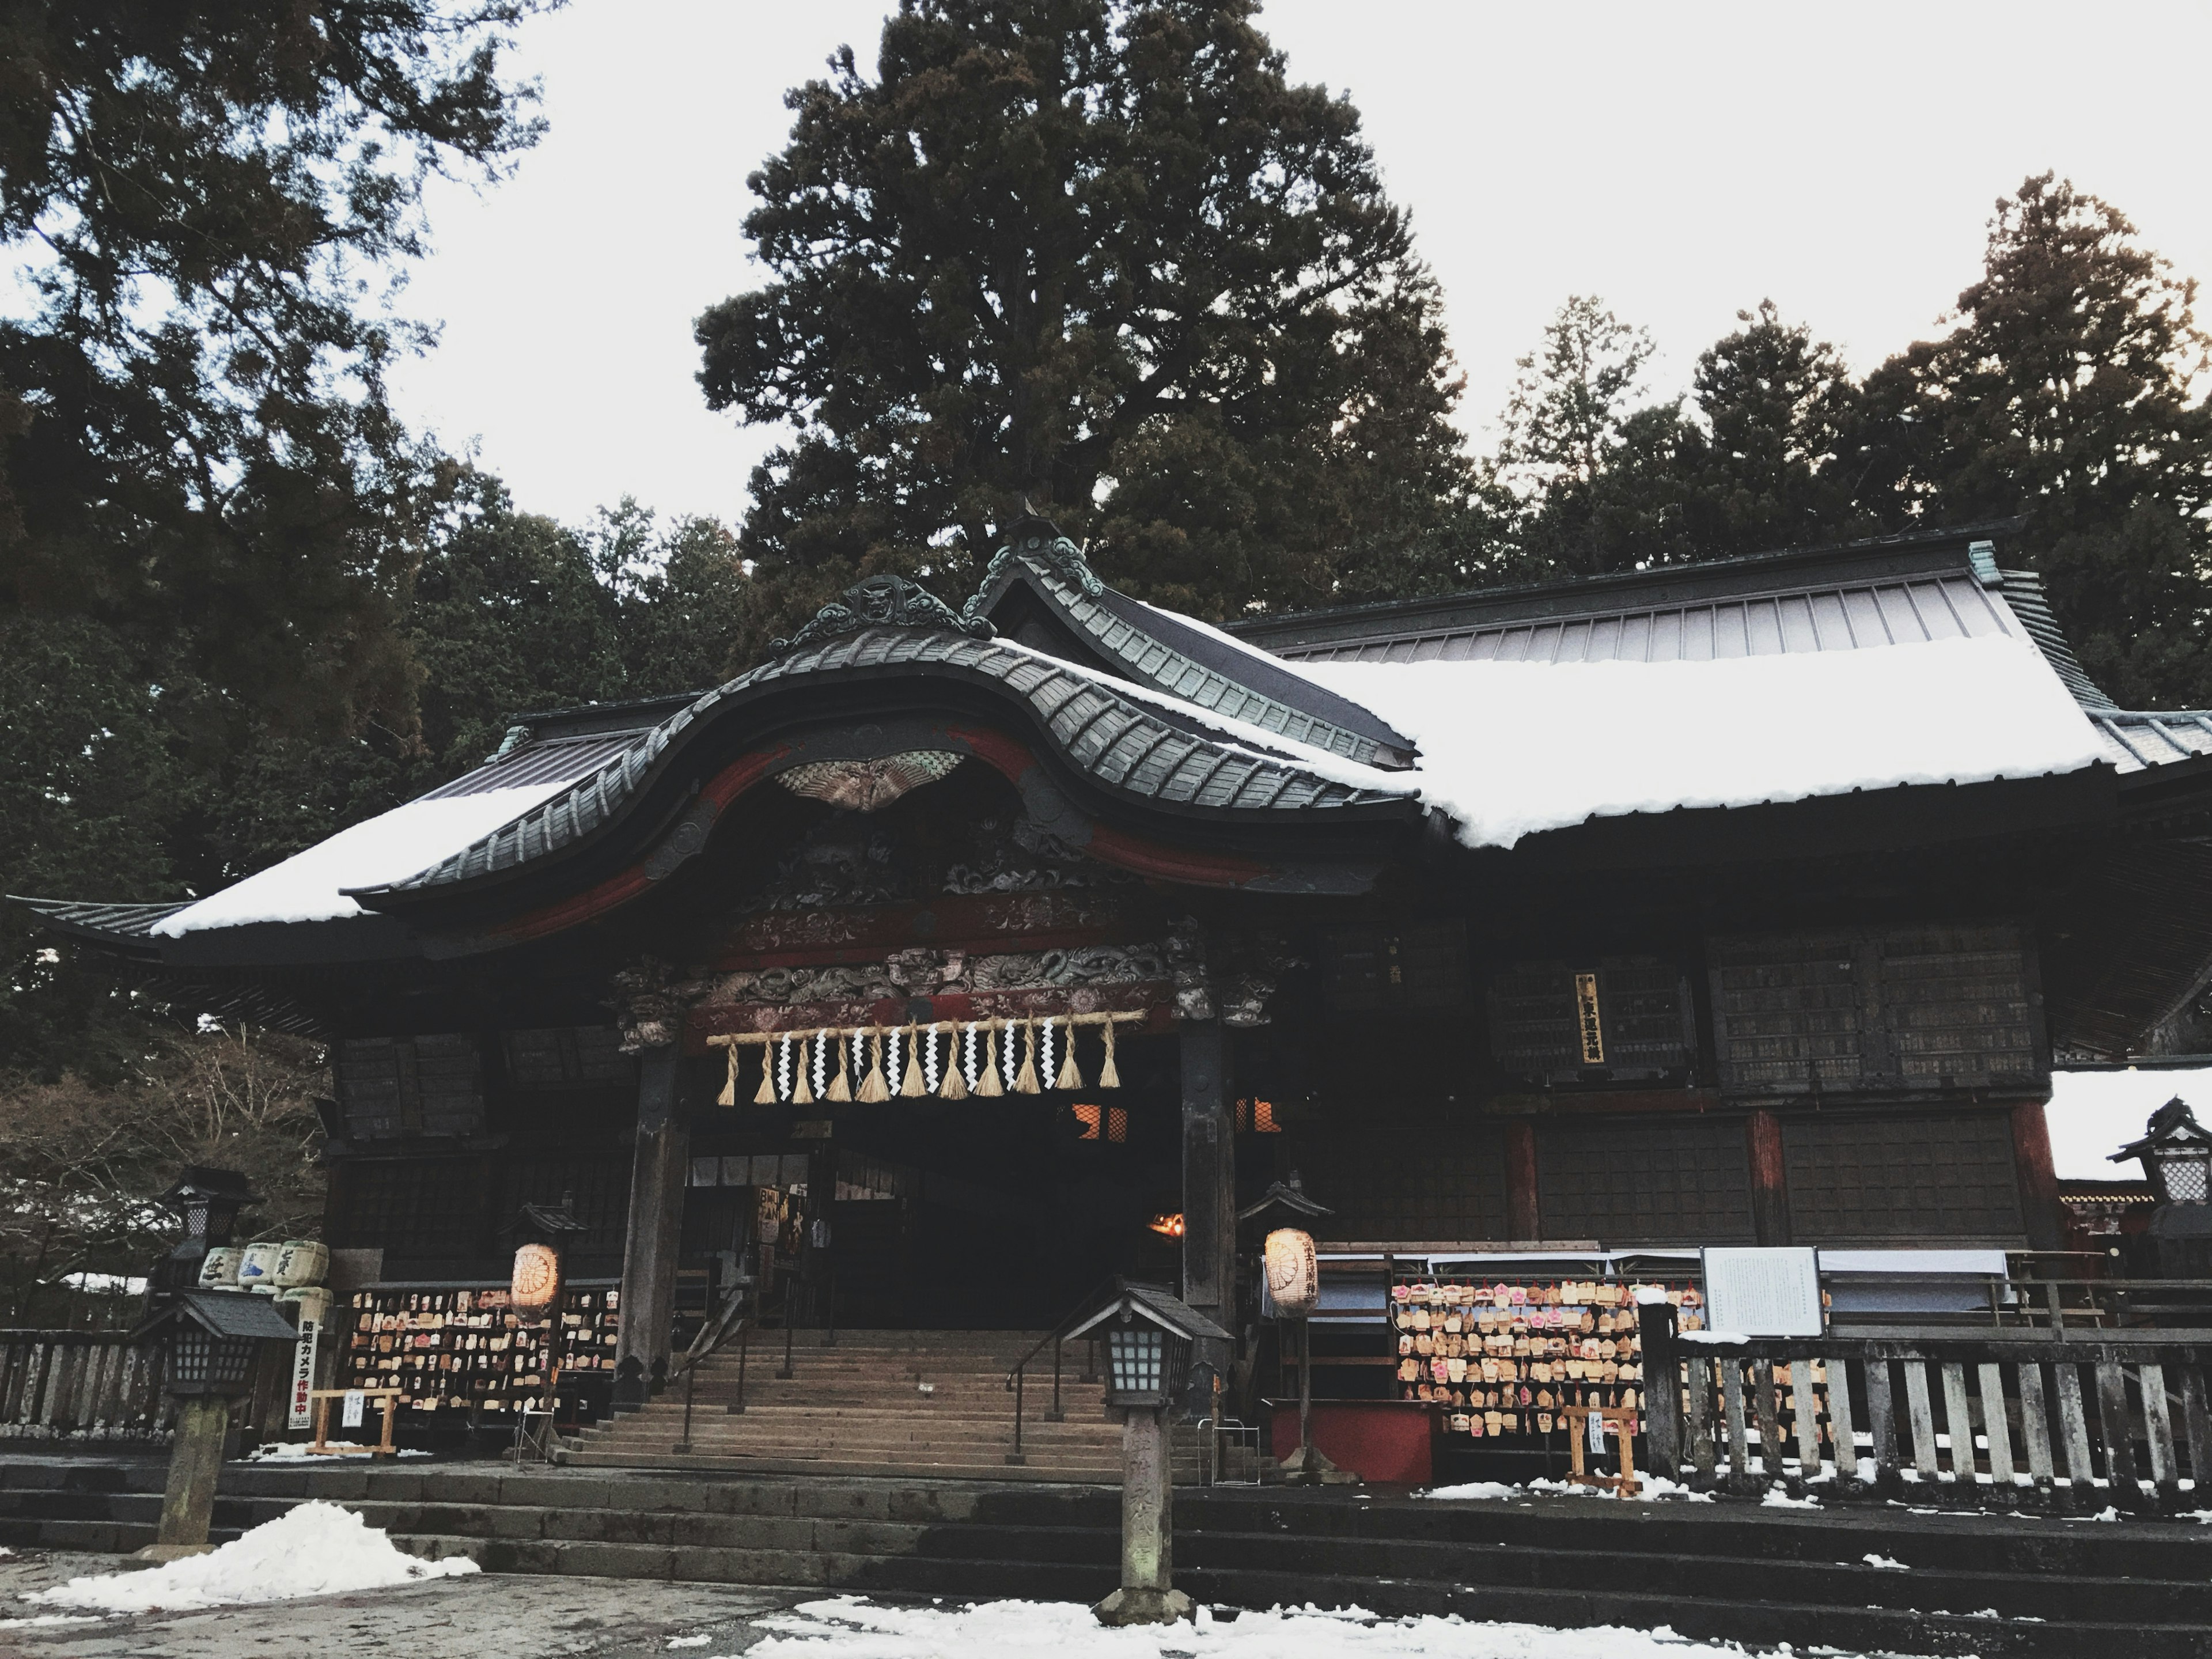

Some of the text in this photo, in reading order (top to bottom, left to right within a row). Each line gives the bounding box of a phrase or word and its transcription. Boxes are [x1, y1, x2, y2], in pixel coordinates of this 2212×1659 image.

[295, 1320, 315, 1415] 防犯カメラ作動中
